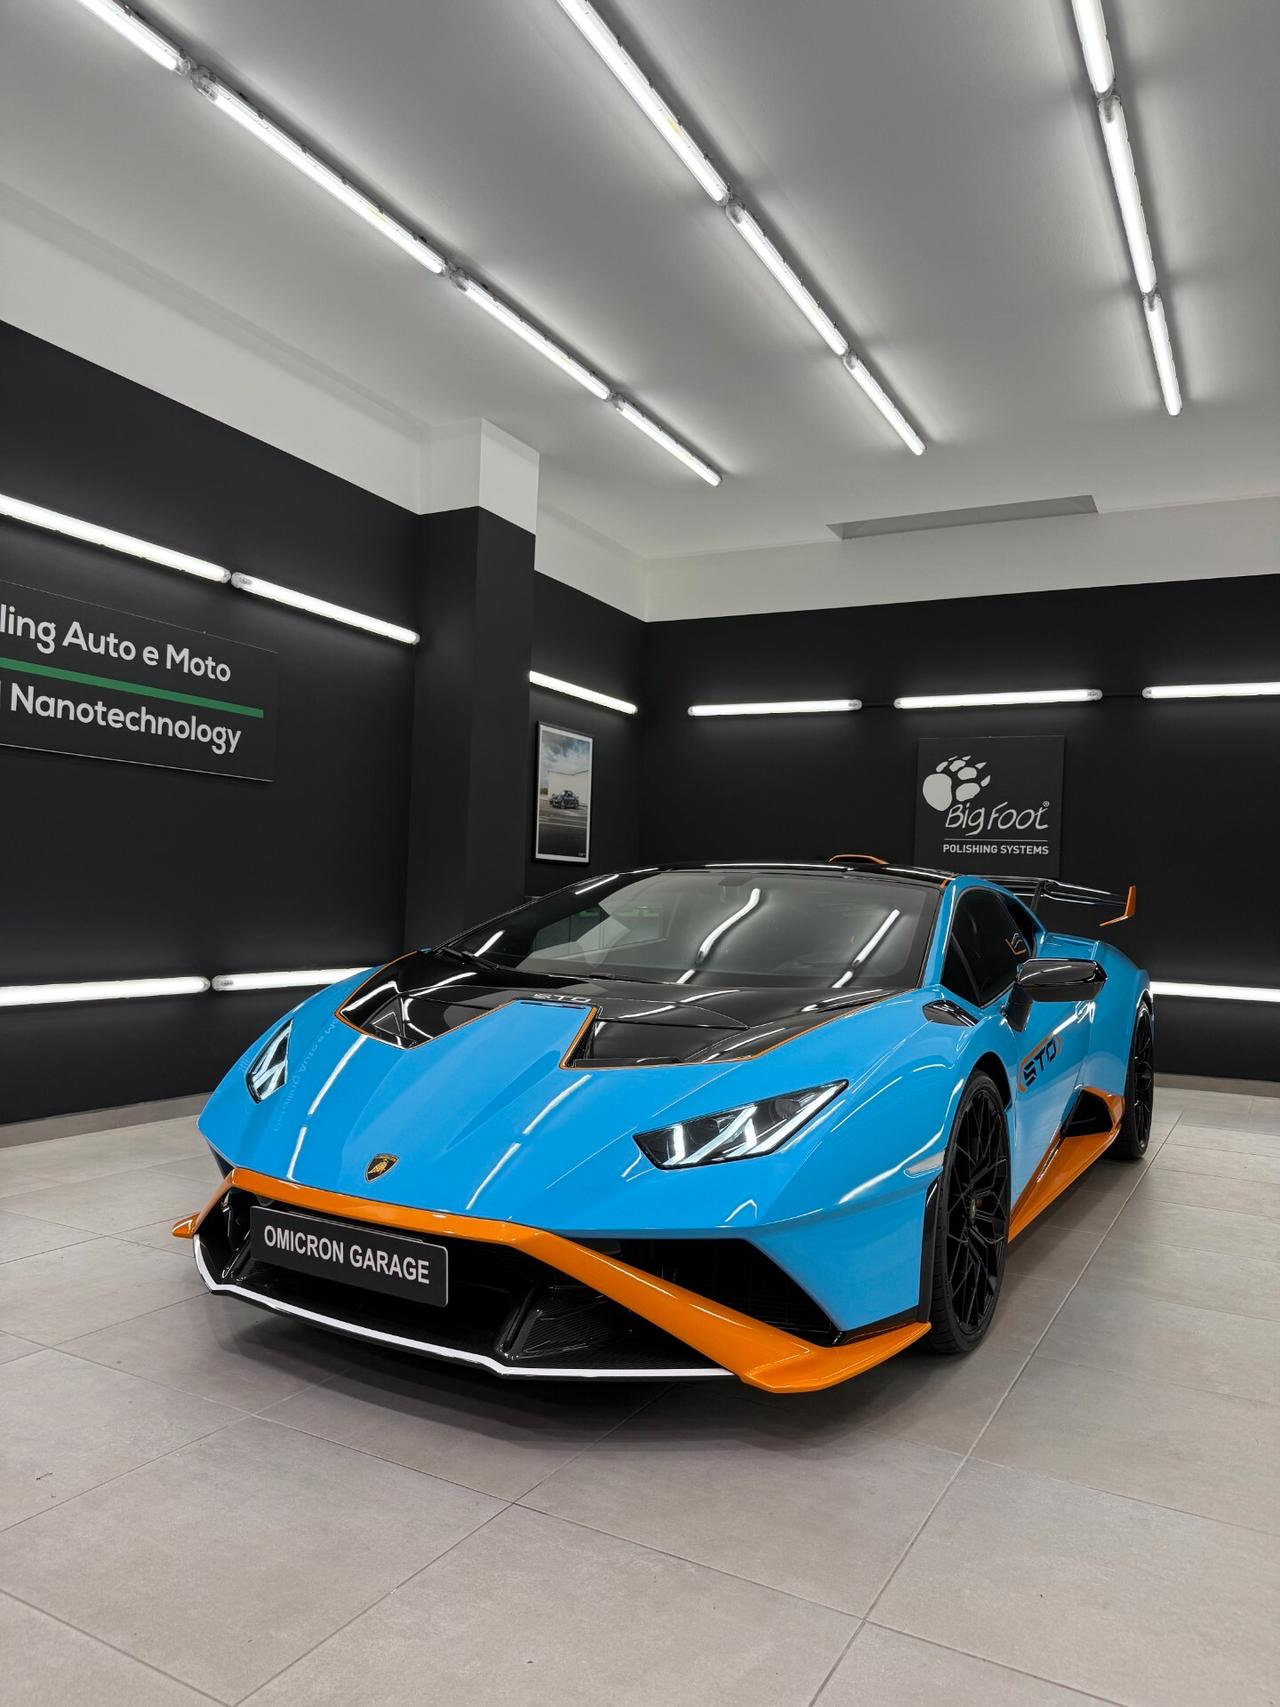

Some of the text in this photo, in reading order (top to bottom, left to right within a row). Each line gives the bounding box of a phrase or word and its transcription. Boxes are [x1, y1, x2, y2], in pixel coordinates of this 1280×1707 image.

[62, 621, 137, 661] Auto
[142, 646, 159, 666] e
[166, 643, 231, 682] Moto
[10, 682, 242, 755] Nanotechnology
[943, 844, 1049, 855] POLISHING SYSTEMS
[264, 1225, 430, 1285] OMICRON GARAGE
